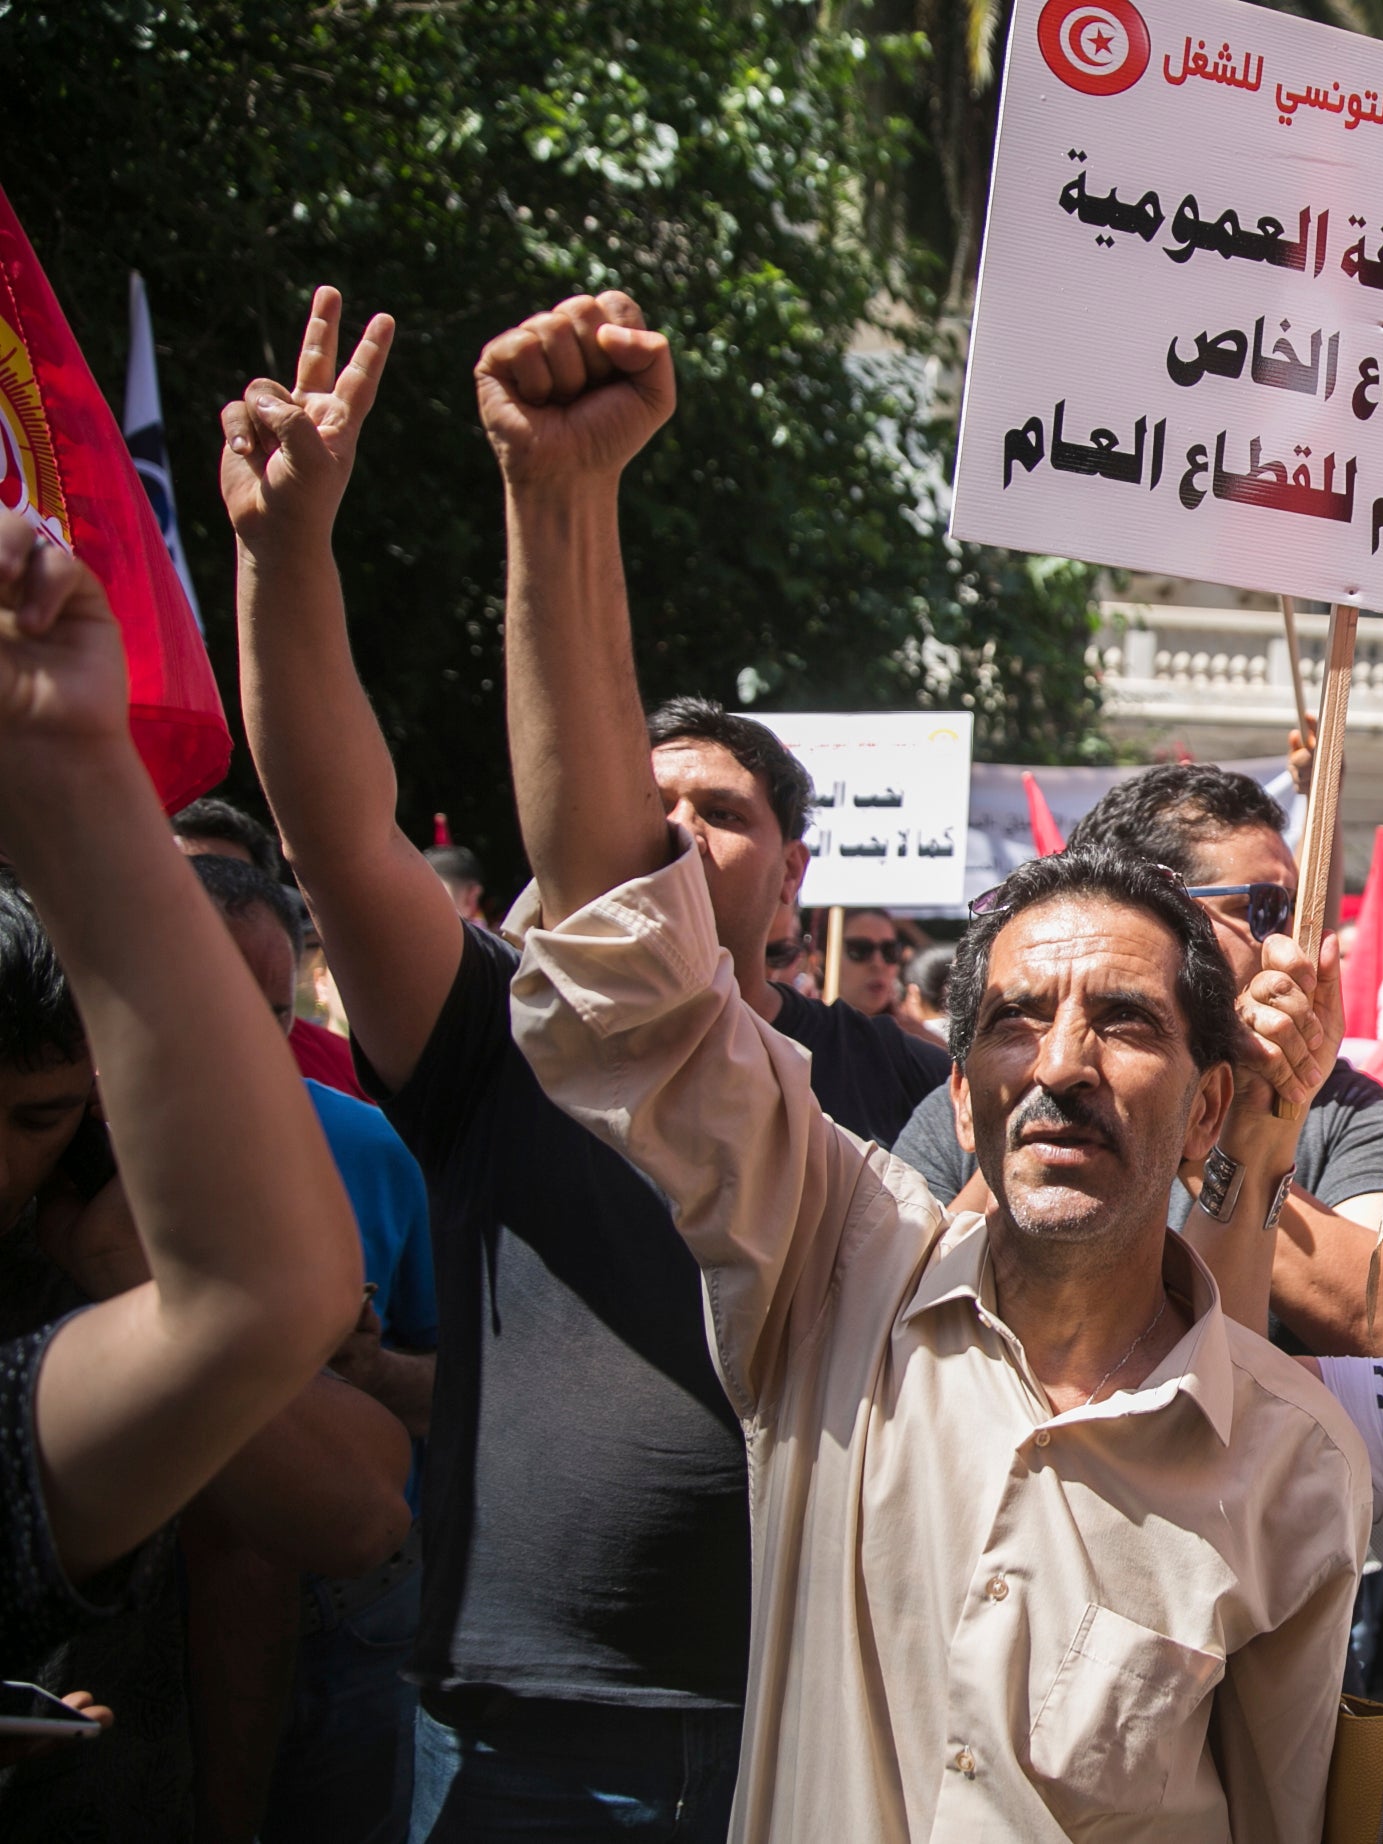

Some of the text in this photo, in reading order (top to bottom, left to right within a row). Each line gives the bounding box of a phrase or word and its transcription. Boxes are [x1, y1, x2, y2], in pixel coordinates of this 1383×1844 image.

[1163, 36, 1264, 92] للشغل
[1058, 148, 1329, 279] العمومية
[1166, 314, 1340, 402] الخاص
[1003, 399, 1167, 491] العام
[1178, 430, 1357, 523] للقطاع
